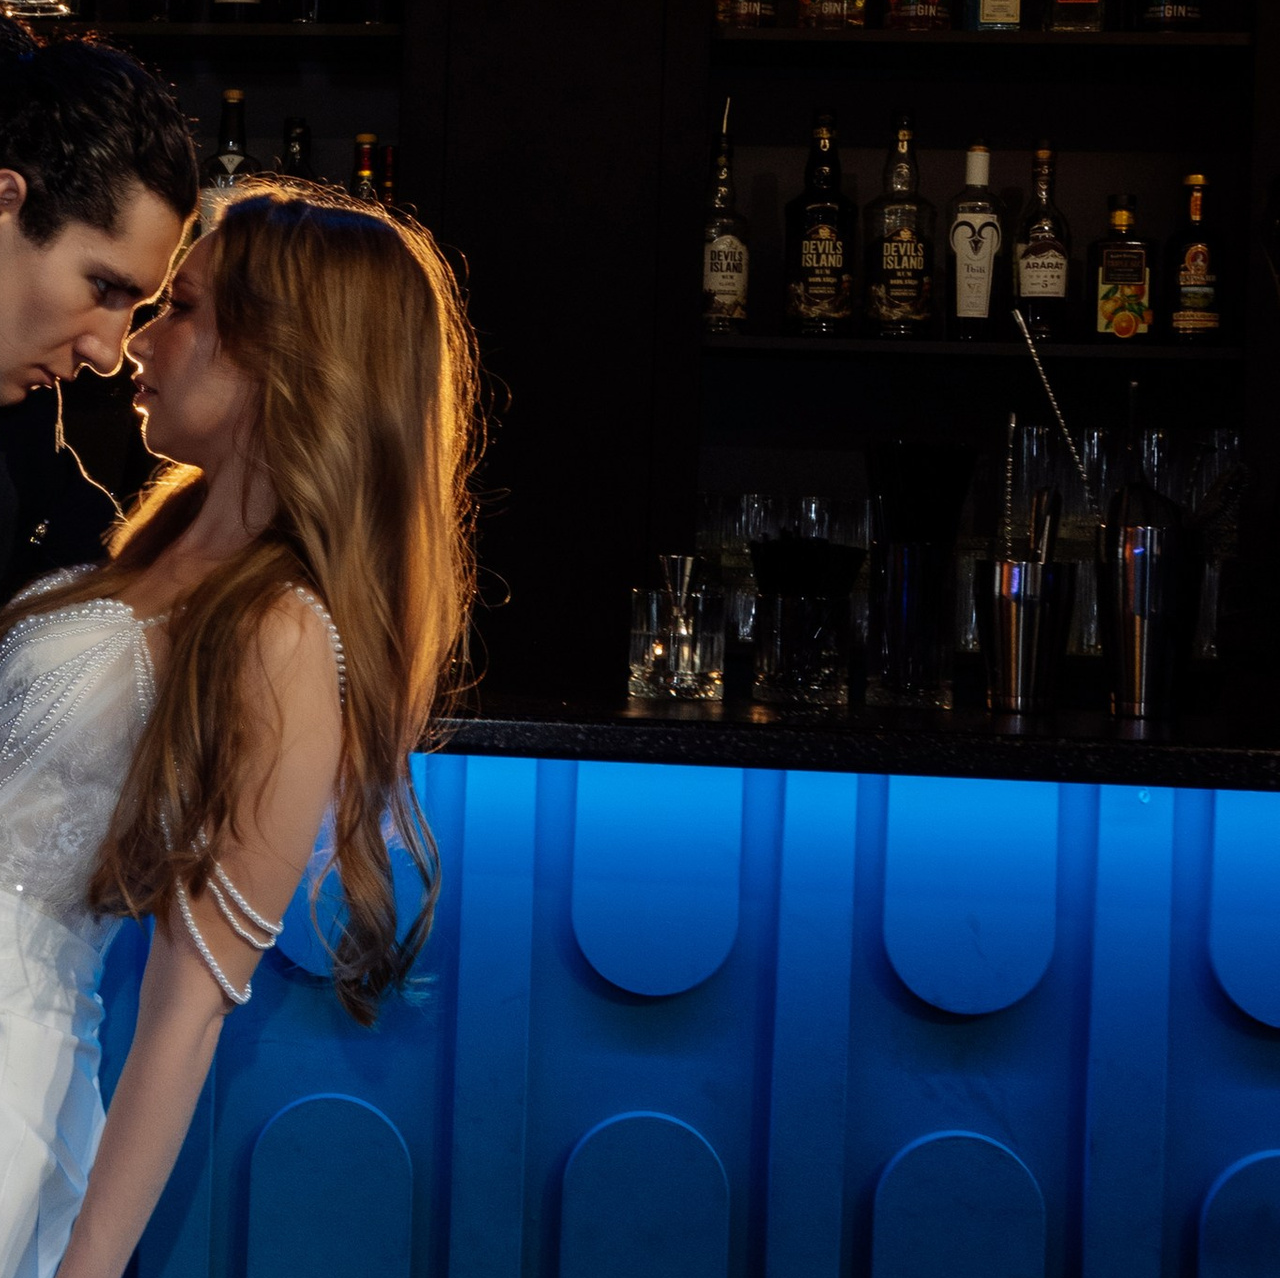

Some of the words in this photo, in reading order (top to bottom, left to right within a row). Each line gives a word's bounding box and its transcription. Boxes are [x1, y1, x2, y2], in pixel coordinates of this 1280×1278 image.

[741, 1, 761, 14] GIN
[821, 1, 841, 14] GIN
[916, 3, 937, 16] GIN
[1164, 4, 1187, 17] GIN
[801, 240, 843, 254] DEVILS
[883, 242, 924, 256] DEVILS
[710, 250, 743, 263] DEVILS
[801, 254, 843, 268] ISLAND
[883, 256, 924, 270] ISLAND
[710, 262, 743, 273] ISLAND
[1024, 261, 1064, 270] ARARAT
